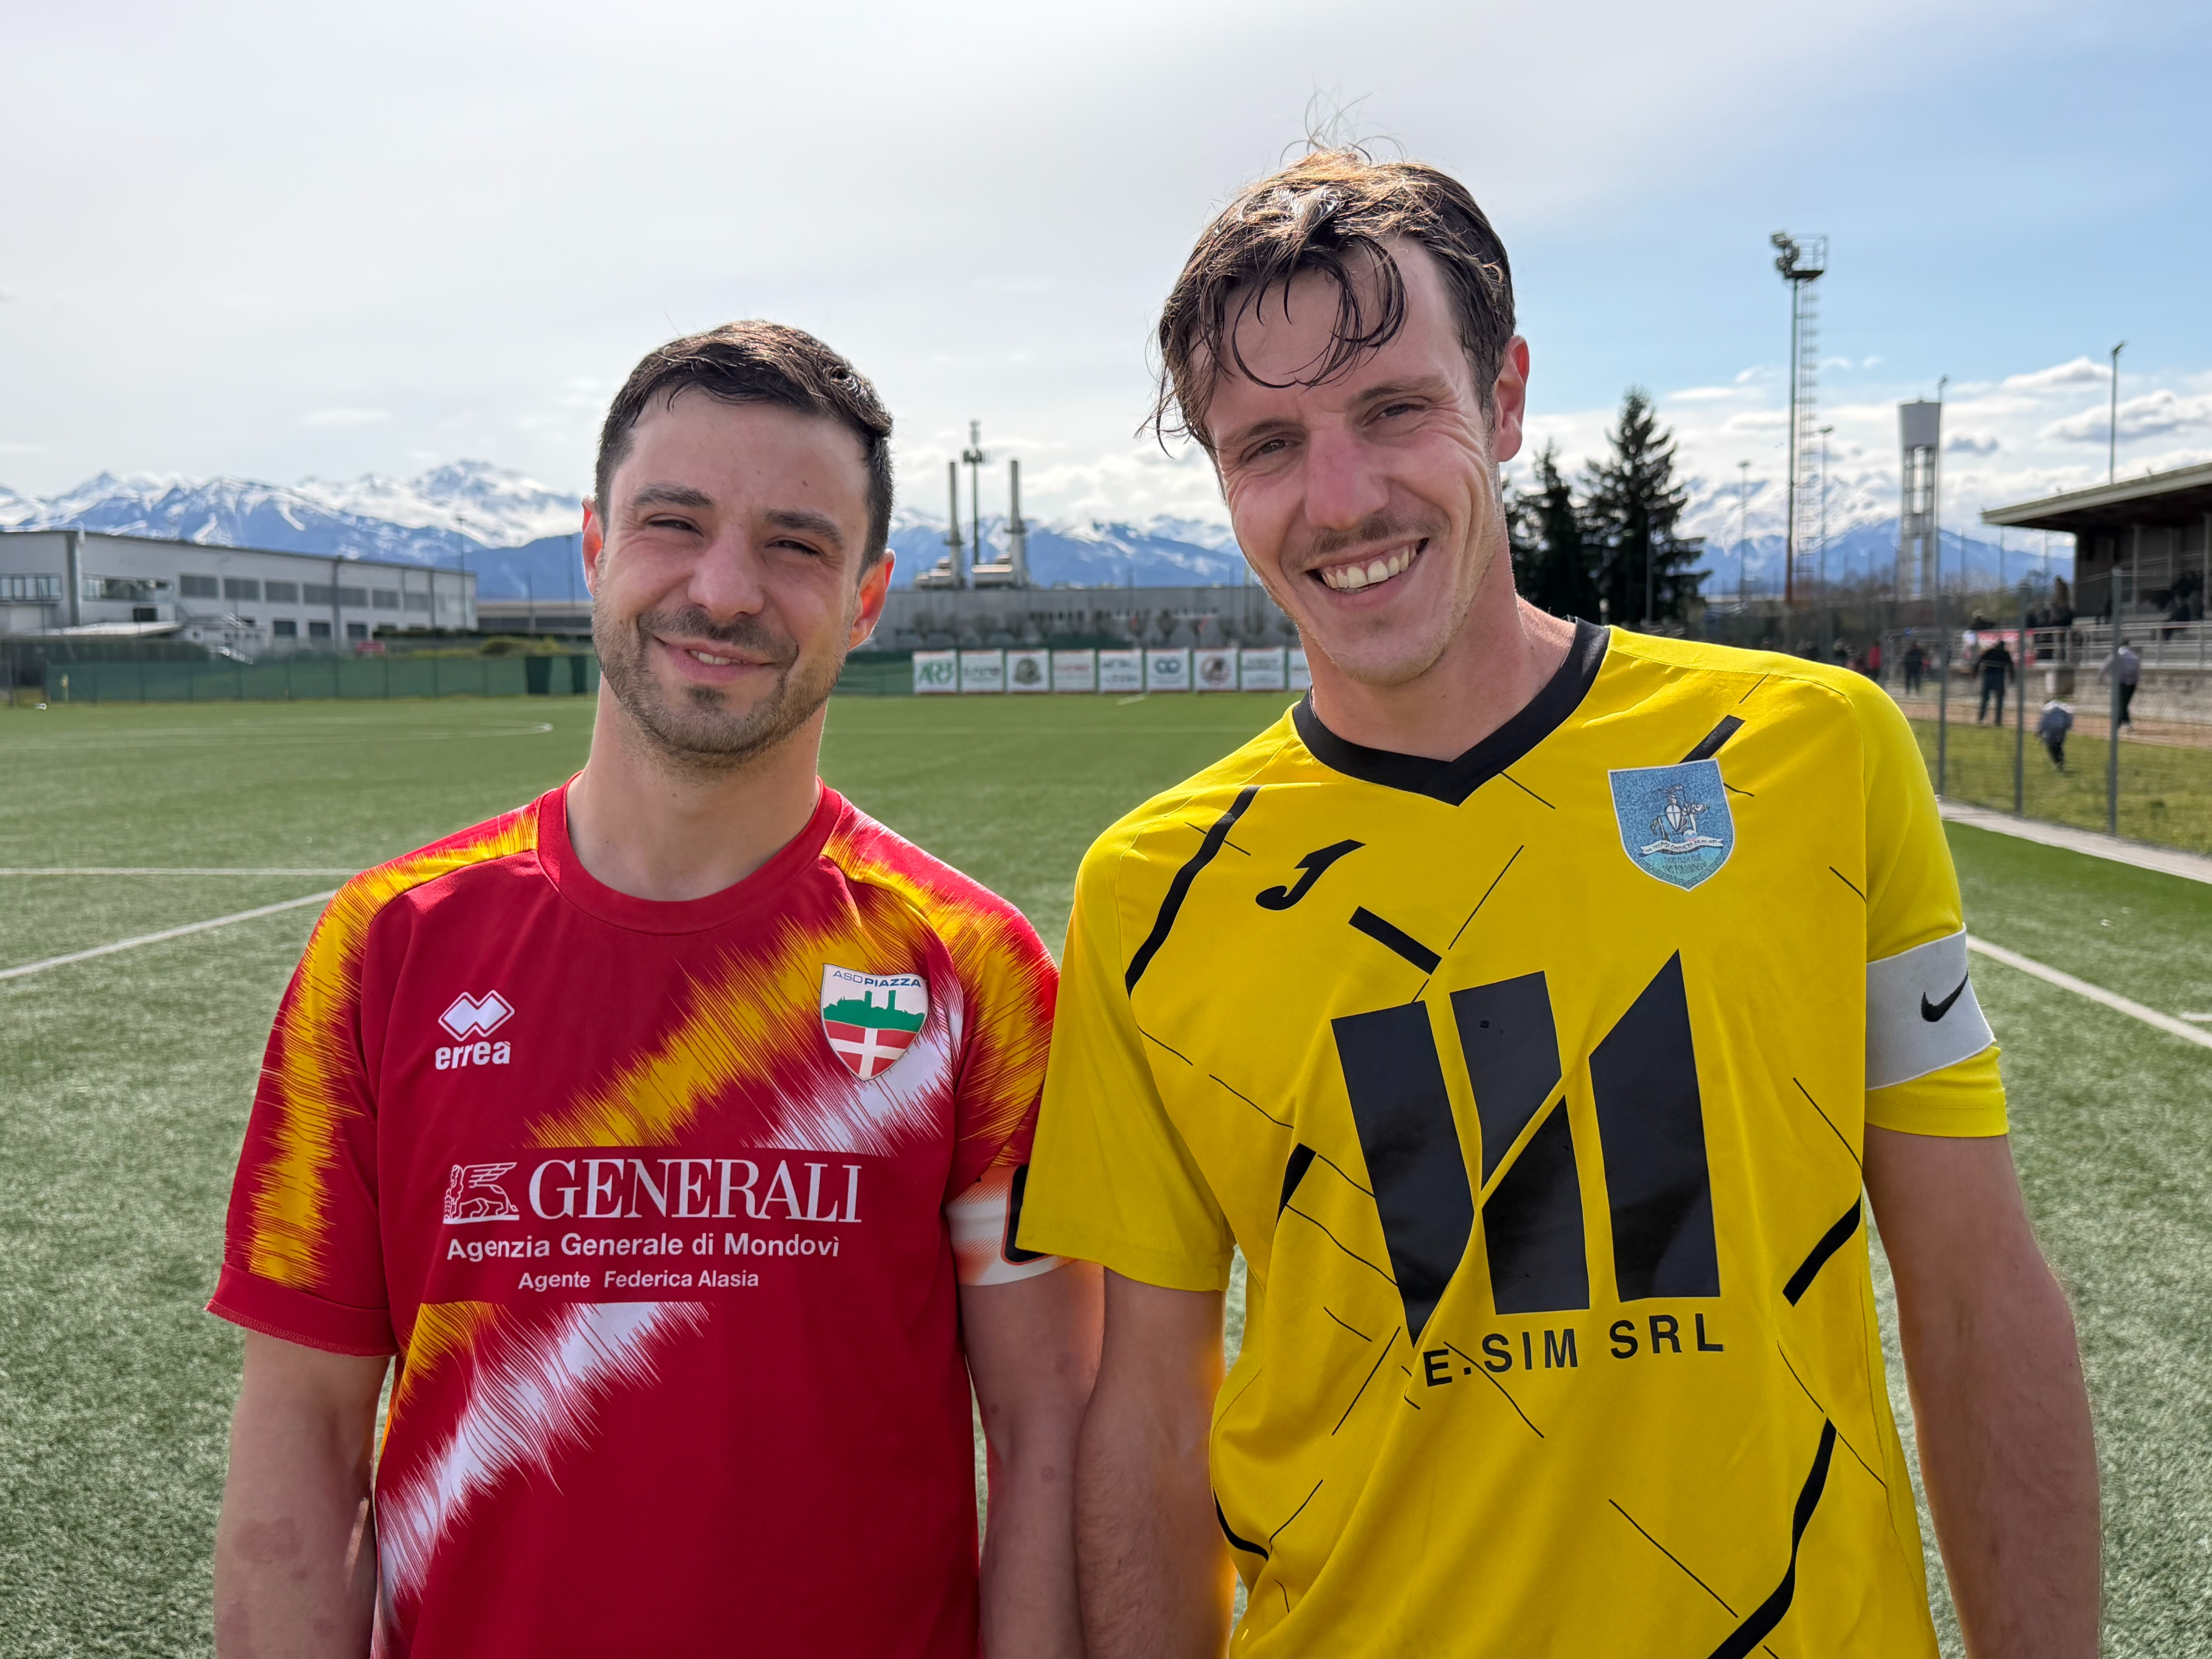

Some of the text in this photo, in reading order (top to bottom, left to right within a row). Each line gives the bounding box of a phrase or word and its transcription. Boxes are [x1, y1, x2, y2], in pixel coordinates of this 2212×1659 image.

[833, 970, 921, 988] ASD PIAZZA
[529, 1159, 862, 1223] GENERALI
[447, 1233, 839, 1262] Agenzia Generale di Mondovì
[519, 1270, 759, 1292] Agente Federica Alasia
[1482, 1329, 1578, 1372] SIM
[1609, 1313, 1724, 1359] SRL
